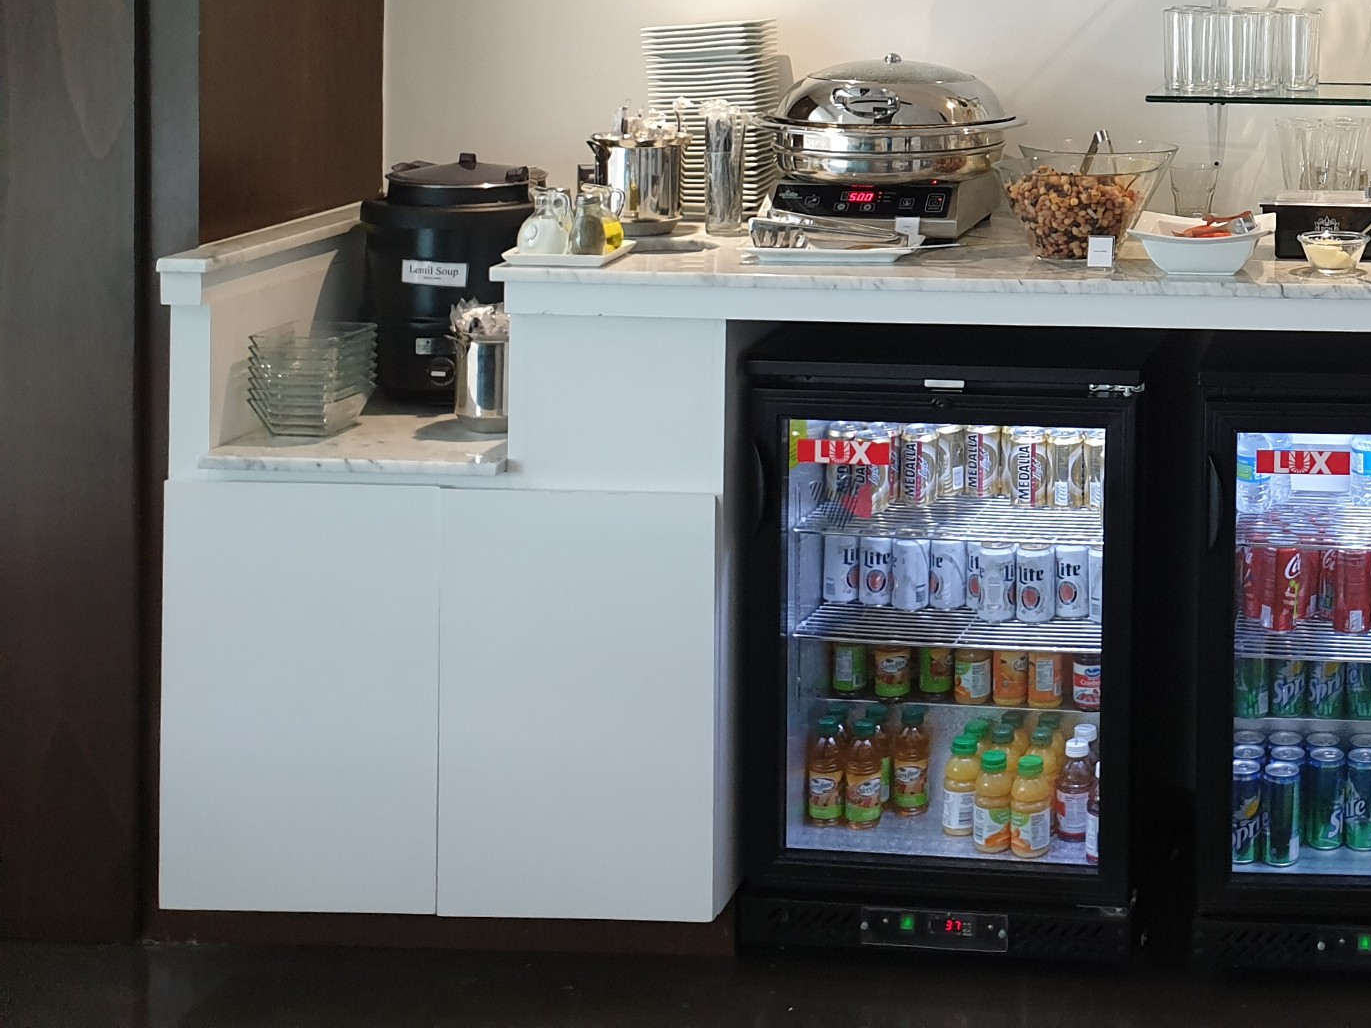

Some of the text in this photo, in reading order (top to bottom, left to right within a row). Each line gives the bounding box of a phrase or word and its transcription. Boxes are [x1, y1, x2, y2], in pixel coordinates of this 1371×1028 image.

[850, 192, 874, 202] 500
[409, 265, 459, 278] Lentil Soup
[814, 439, 872, 465] LUX
[968, 434, 978, 488] MEDALLA
[904, 443, 916, 497] MEDALLA
[1273, 451, 1333, 475] LUX
[1018, 445, 1030, 500] MEDALLA
[864, 551, 891, 568] Lite
[1018, 567, 1044, 585] Lite
[1056, 562, 1081, 579] Lite
[945, 920, 962, 932] 37
